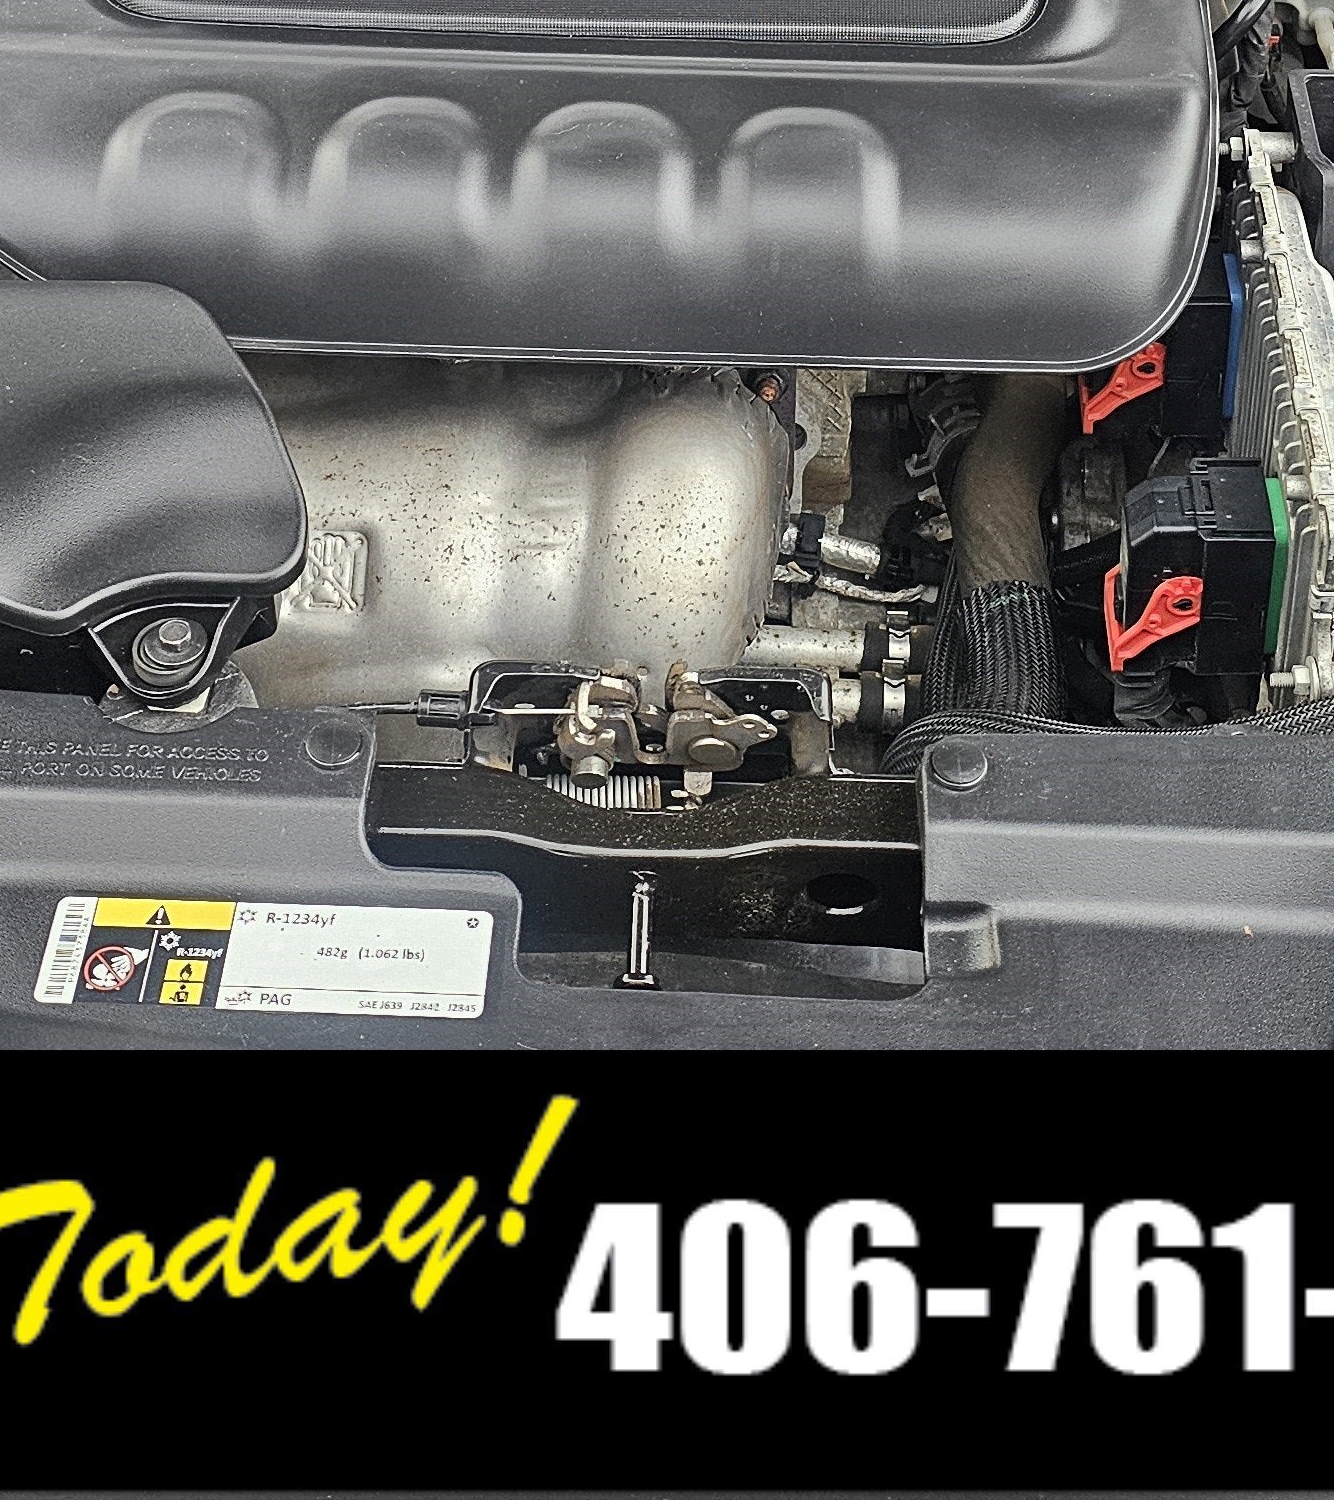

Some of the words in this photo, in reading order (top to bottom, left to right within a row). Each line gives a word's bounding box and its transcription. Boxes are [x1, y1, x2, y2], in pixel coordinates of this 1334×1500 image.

[61, 740, 122, 757] PANEL
[126, 743, 164, 759] FOR
[166, 746, 241, 762] ACCESS
[245, 748, 270, 763] TO
[20, 761, 72, 777] PORT
[75, 762, 105, 778] ON
[108, 764, 166, 780] SOME
[265, 911, 337, 929] R-1234yf
[176, 947, 224, 961] R-1234yf
[316, 946, 348, 960] 482g
[357, 946, 400, 961] (1.062
[401, 948, 426, 963] lbs)
[259, 993, 293, 1006] PAG
[357, 1000, 378, 1010] SAE
[379, 1000, 404, 1011] J639
